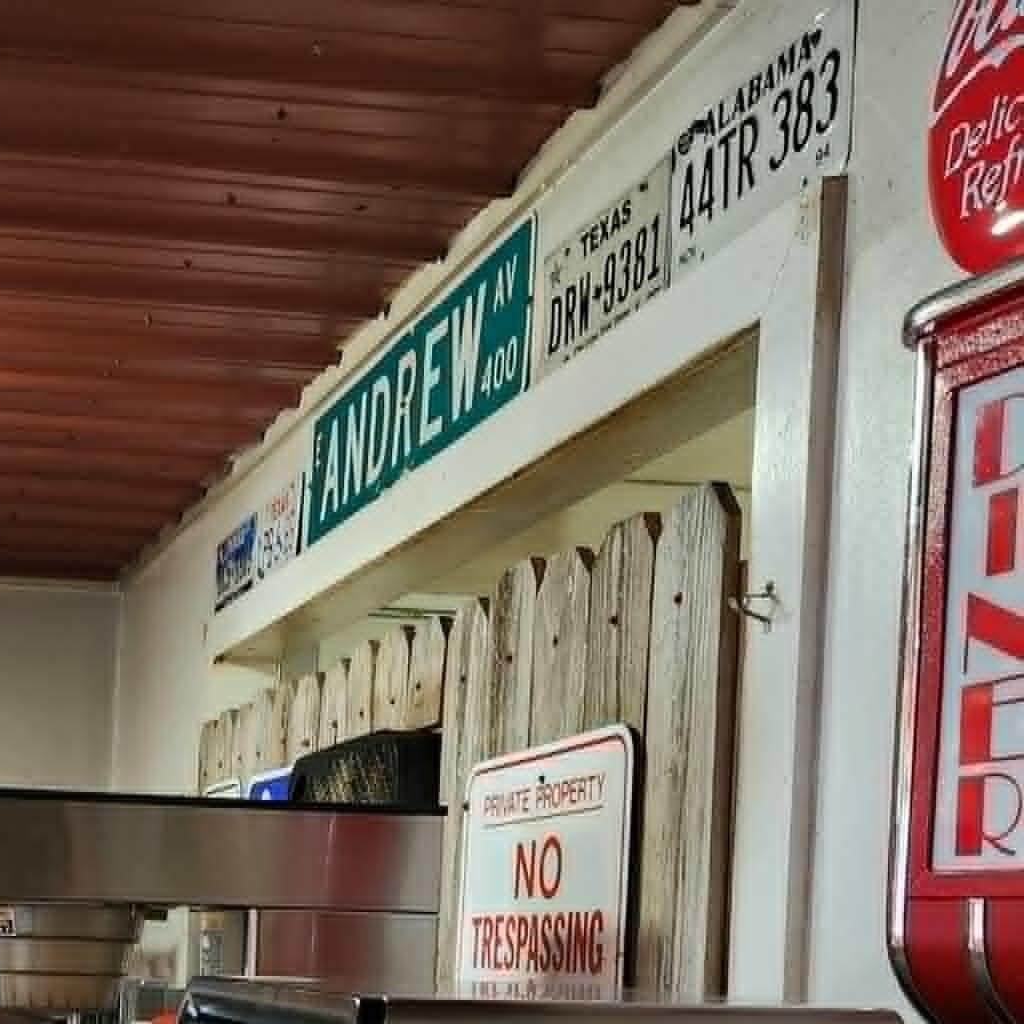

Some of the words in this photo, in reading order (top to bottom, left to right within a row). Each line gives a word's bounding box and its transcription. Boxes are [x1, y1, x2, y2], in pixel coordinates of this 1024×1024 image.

[703, 31, 813, 143] ALABAMA
[679, 115, 759, 238] 44TR
[769, 48, 841, 171] 383
[580, 199, 632, 260] TEXAS
[319, 279, 487, 523] ANDREW
[493, 252, 518, 313] AV
[481, 335, 519, 398] 400
[482, 786, 531, 817] PRIVATE
[535, 773, 607, 811] PROPERTY
[514, 834, 563, 900] NO
[472, 908, 607, 975] TRESPASSING
